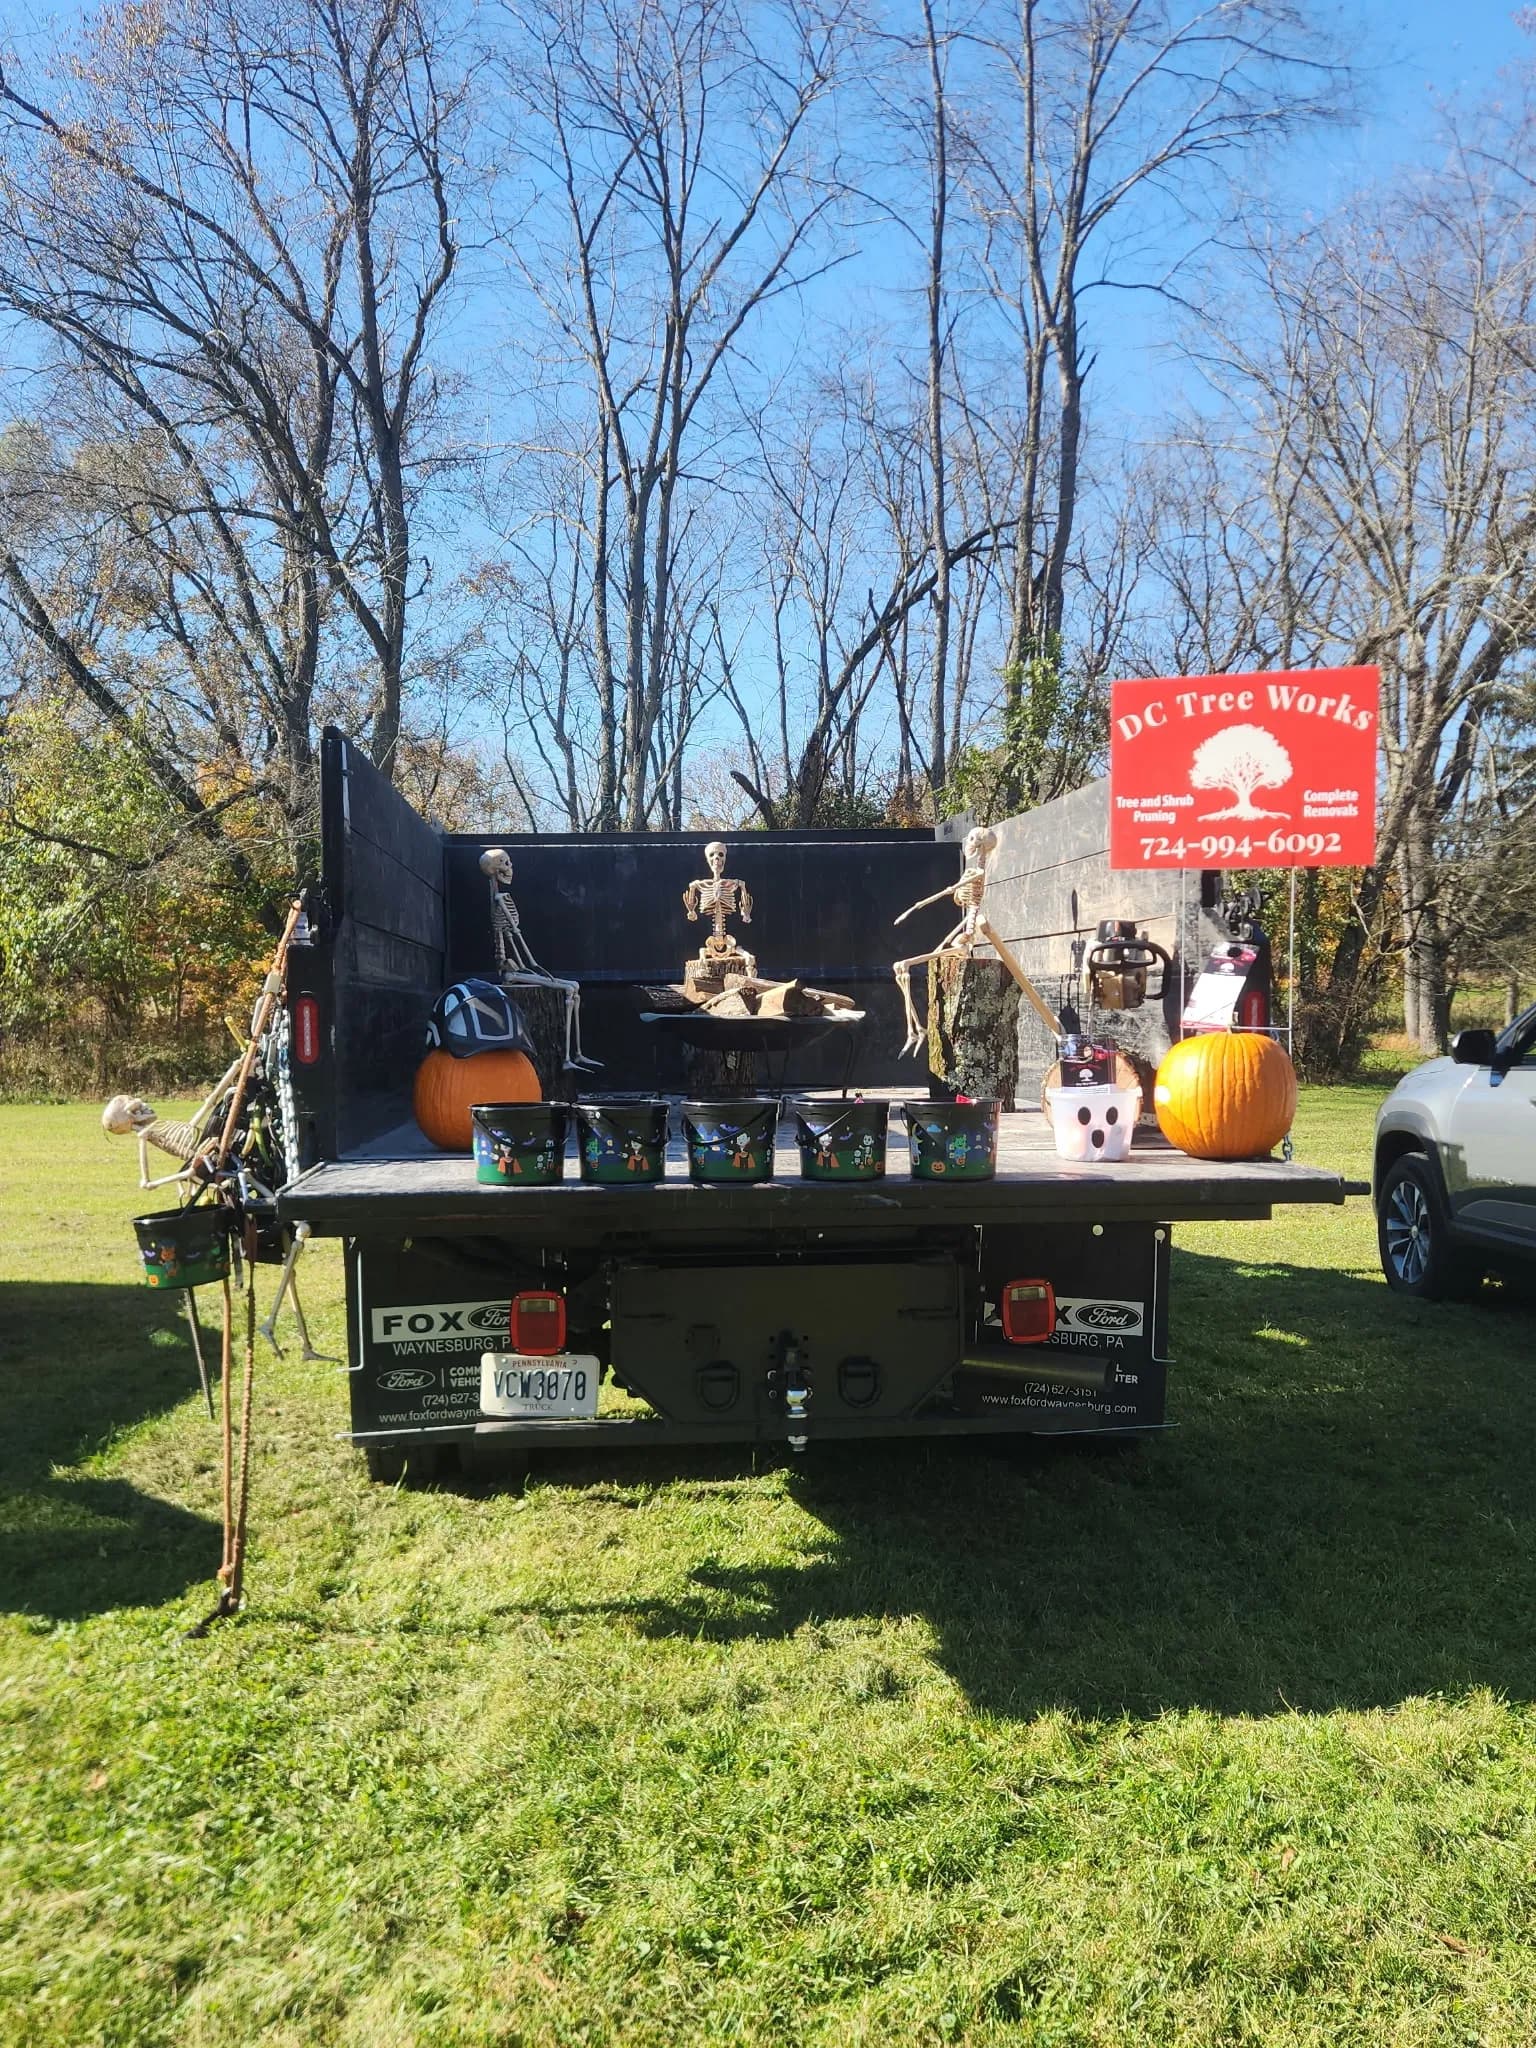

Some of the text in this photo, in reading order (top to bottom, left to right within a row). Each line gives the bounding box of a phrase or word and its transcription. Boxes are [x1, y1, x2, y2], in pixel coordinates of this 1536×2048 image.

[1116, 684, 1374, 742] DC Tree Works
[1116, 794, 1194, 809] Tree and Shrub
[1303, 789, 1359, 802] Complete
[1133, 811, 1176, 825] Pruning
[1303, 804, 1359, 817] Removals
[1140, 828, 1342, 860] 724-994-6092
[383, 1311, 465, 1336] FOX
[1088, 1307, 1129, 1326] Ford
[393, 1336, 511, 1356] WAYNESBURG, P
[1050, 1333, 1124, 1351] SBURG, PA
[512, 1359, 567, 1369] PENNSYLVANIA
[387, 1371, 426, 1388] Ford
[449, 1377, 481, 1388] VEHIC
[494, 1370, 586, 1401] VCW3070
[1024, 1382, 1050, 1395] (724)
[422, 1392, 480, 1407] (724) 627-3
[524, 1403, 552, 1411] TRUCK
[378, 1407, 481, 1423] www.foxfordwayne
